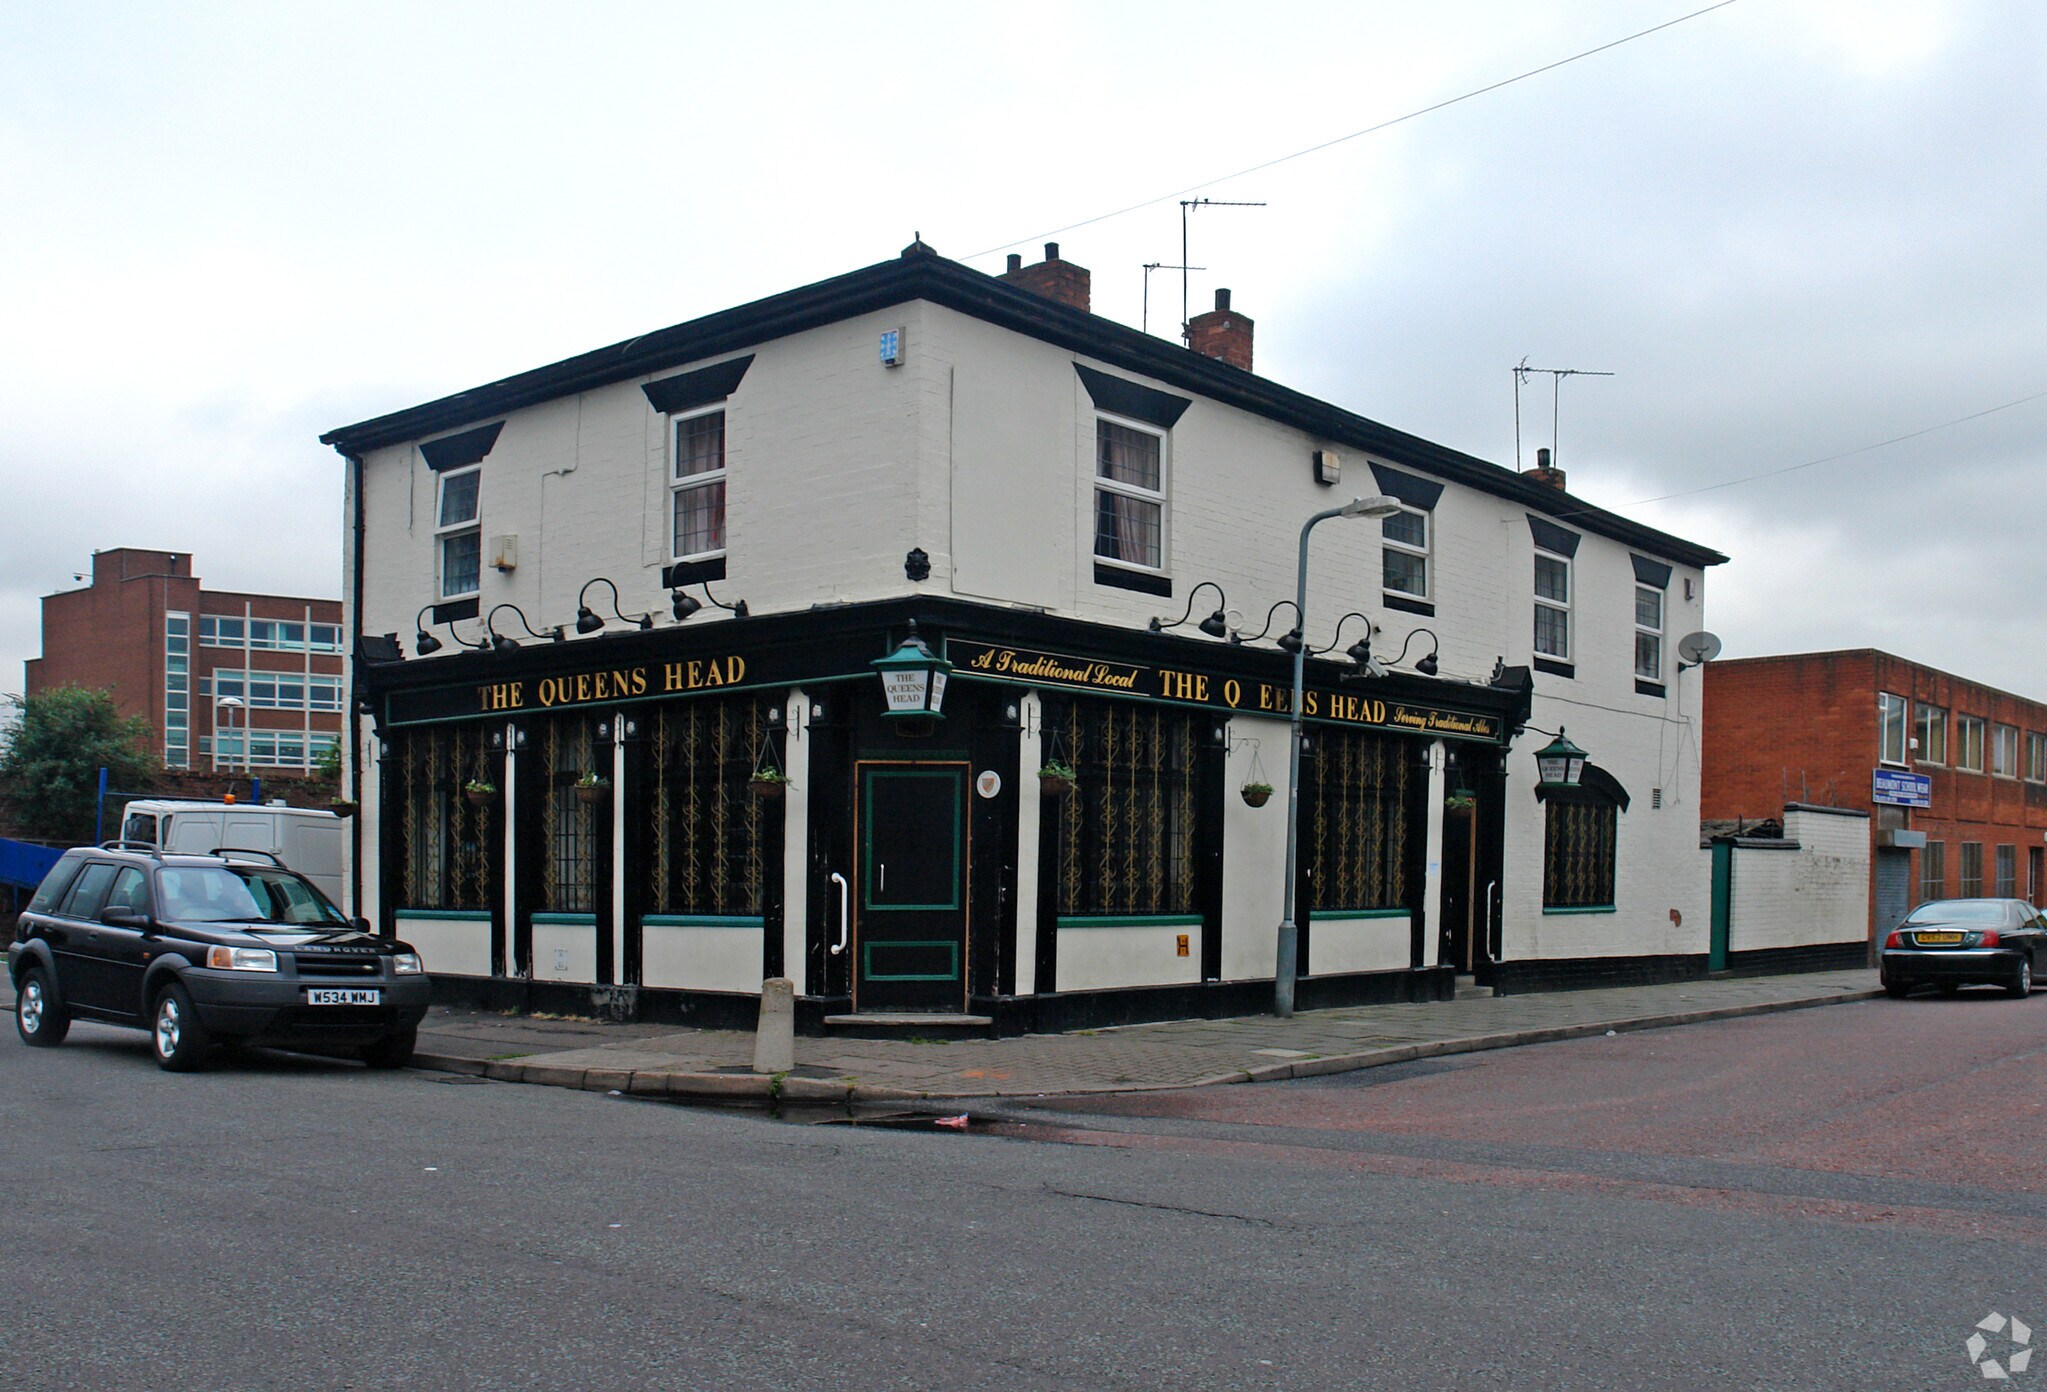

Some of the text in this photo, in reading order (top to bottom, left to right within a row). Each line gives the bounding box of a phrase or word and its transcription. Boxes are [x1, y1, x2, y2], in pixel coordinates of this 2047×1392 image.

[895, 673, 915, 682] THE
[971, 649, 1138, 688] A Traditional Local
[478, 655, 746, 711] THE QUEENS HEAD
[887, 684, 925, 693] QUEENS
[893, 694, 920, 703] HEAD
[1159, 669, 1209, 701] THE
[1330, 694, 1386, 724] HEAD
[1394, 706, 1427, 731] Serving
[1428, 711, 1474, 732] Traditional
[314, 992, 375, 1003] W534 WMJ
